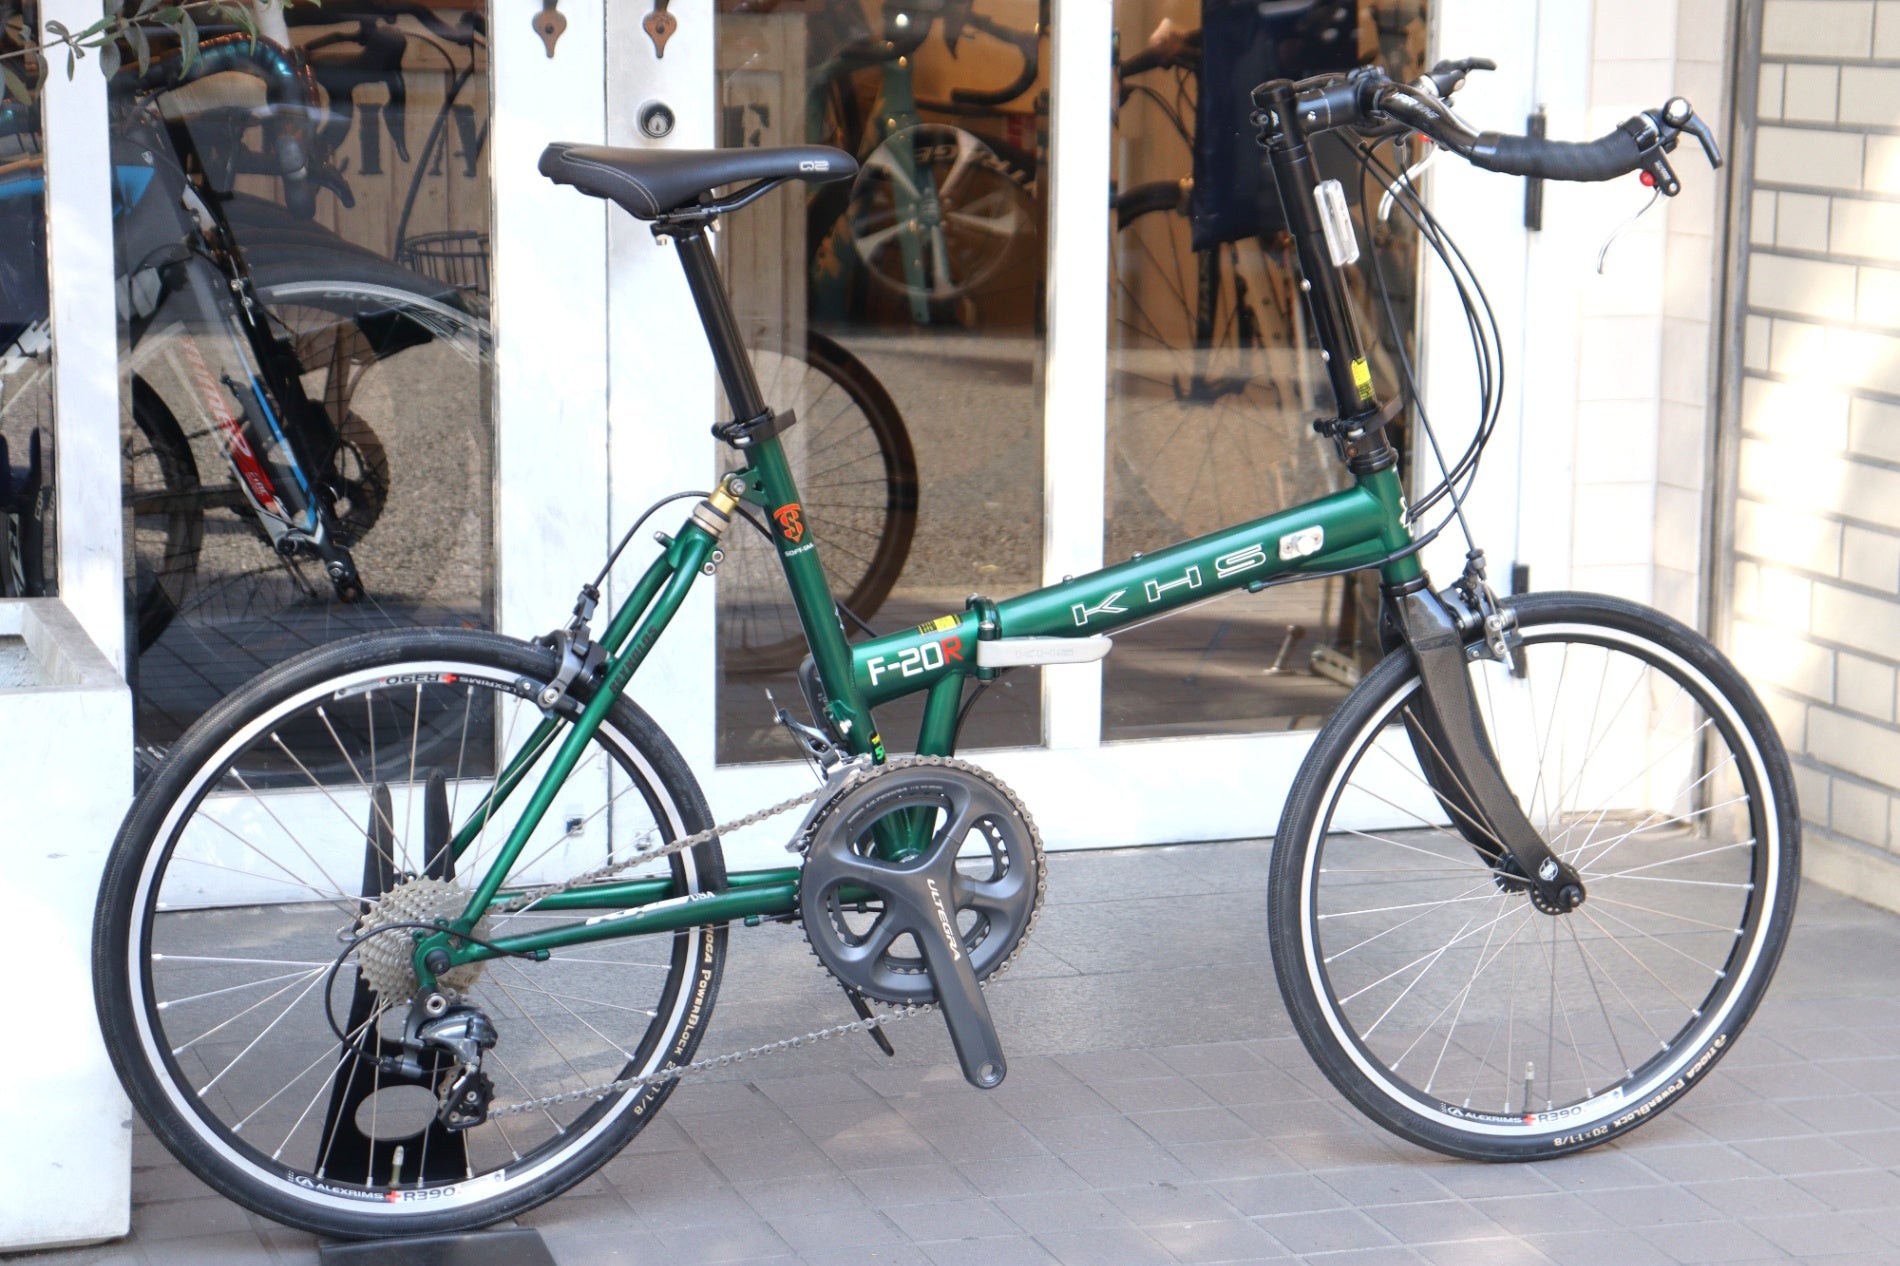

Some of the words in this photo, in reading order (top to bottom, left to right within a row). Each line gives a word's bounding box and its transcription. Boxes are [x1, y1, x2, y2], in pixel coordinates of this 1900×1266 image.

[1071, 543, 1267, 627] KHS
[866, 635, 965, 687] F-20R
[385, 673, 439, 685] R390
[690, 890, 716, 901] USA
[926, 878, 961, 962] ULTEGRA
[1686, 1046, 1719, 1079] TIOGA
[1464, 1111, 1522, 1124] ALEXRIMS
[1538, 1106, 1583, 1124] R390
[316, 1183, 385, 1200] ALEXRIMS
[403, 1186, 456, 1202] R390
